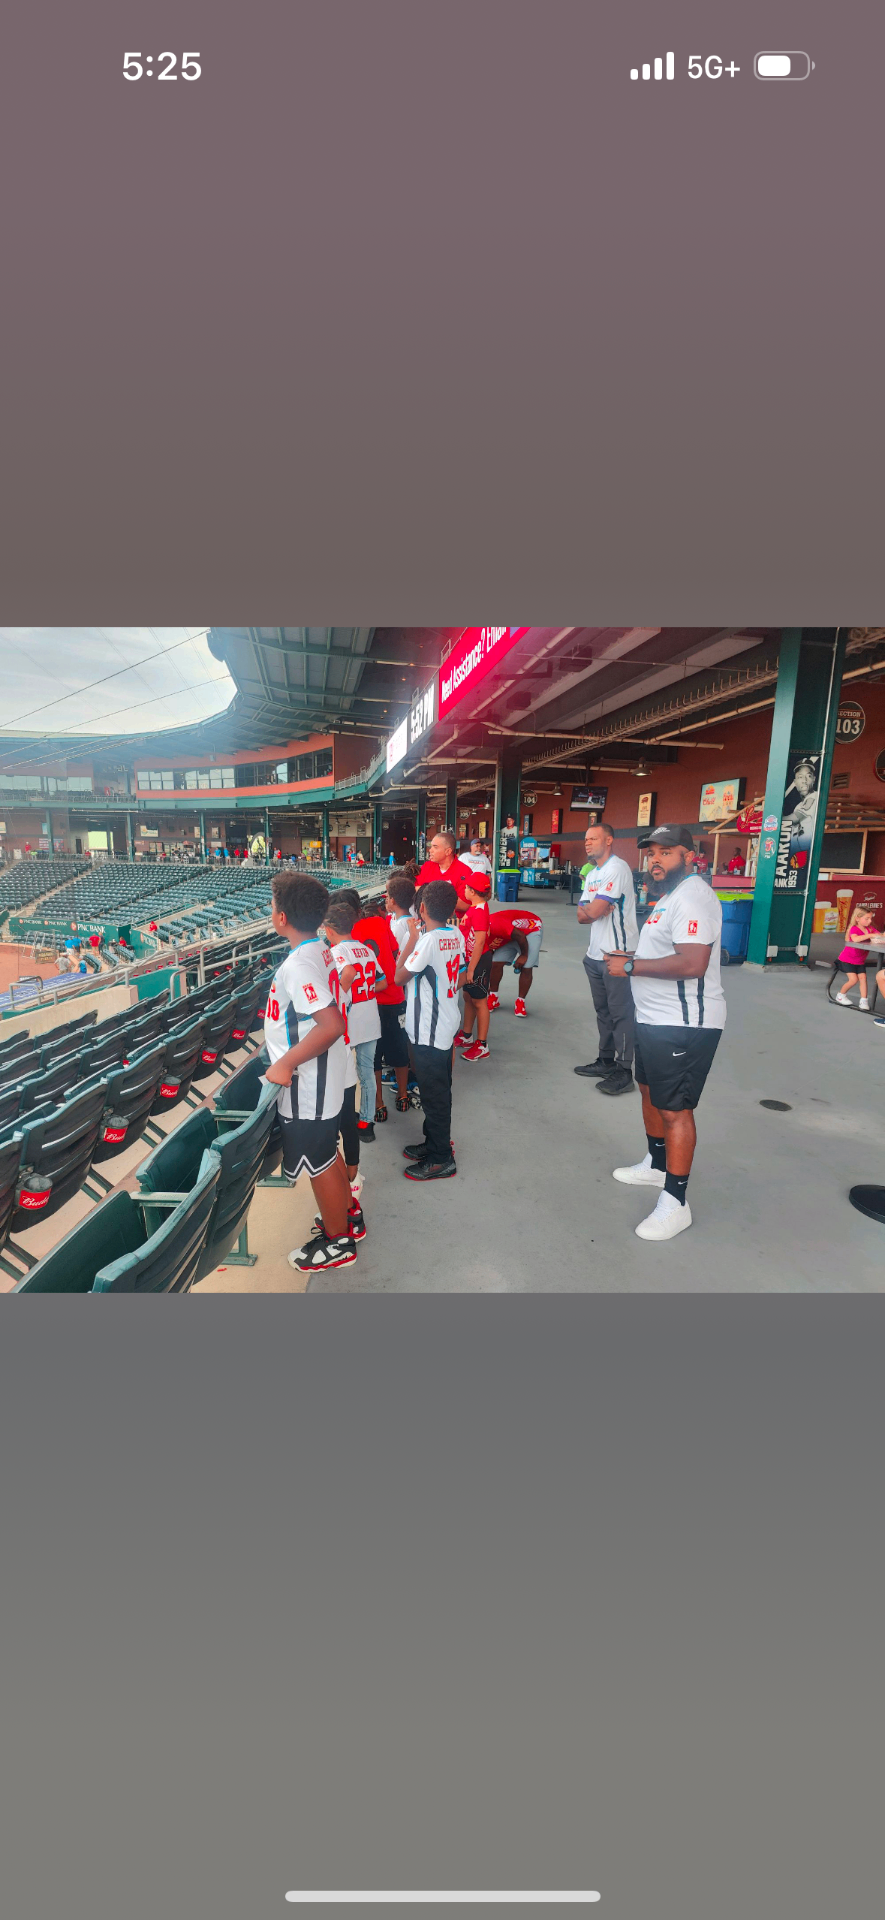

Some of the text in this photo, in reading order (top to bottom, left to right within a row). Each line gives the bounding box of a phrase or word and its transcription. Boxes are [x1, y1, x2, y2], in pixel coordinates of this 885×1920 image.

[441, 669, 453, 704] Need
[453, 628, 486, 692] Assistance?
[423, 683, 435, 731] PM
[836, 718, 860, 735] 103
[774, 877, 789, 889] ANK
[788, 869, 798, 889] 1953
[77, 923, 106, 934] PNC BANK
[351, 961, 376, 1005] 22
